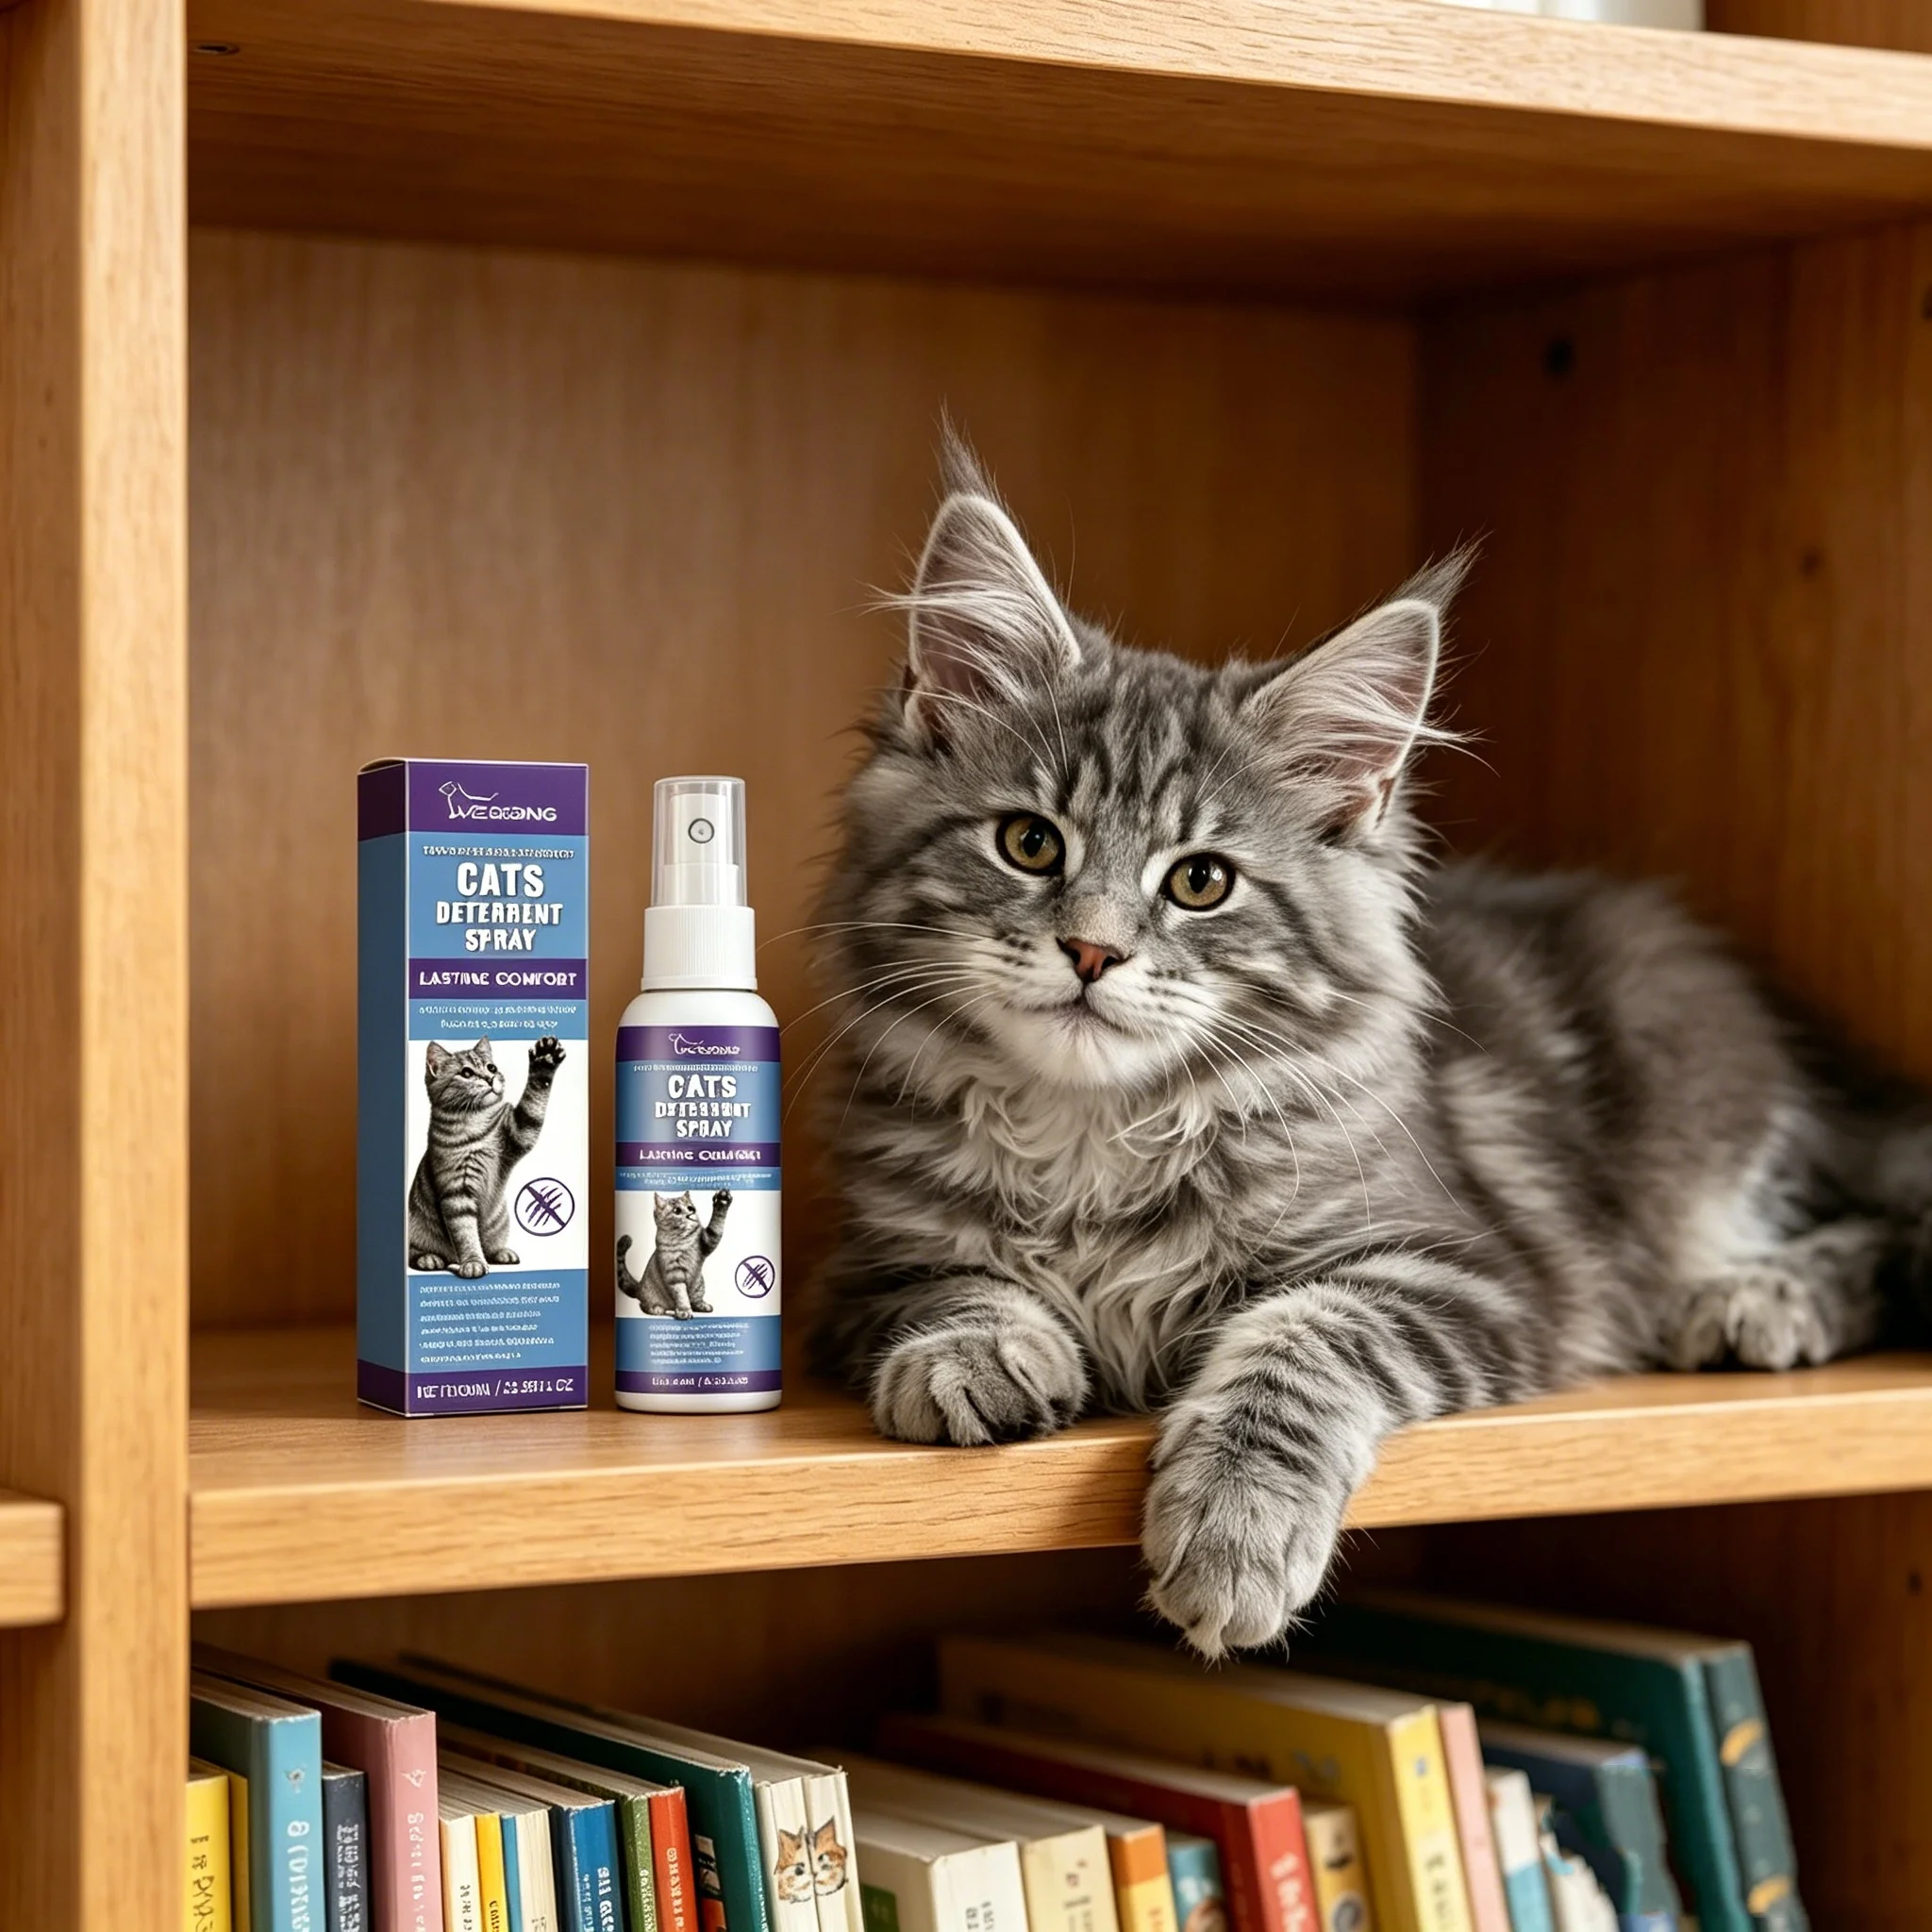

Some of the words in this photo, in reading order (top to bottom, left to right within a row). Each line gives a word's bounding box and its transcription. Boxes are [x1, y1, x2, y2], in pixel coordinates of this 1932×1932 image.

[457, 861, 545, 898] CATS
[465, 927, 538, 952] SPRAY
[668, 1074, 737, 1099] CATS
